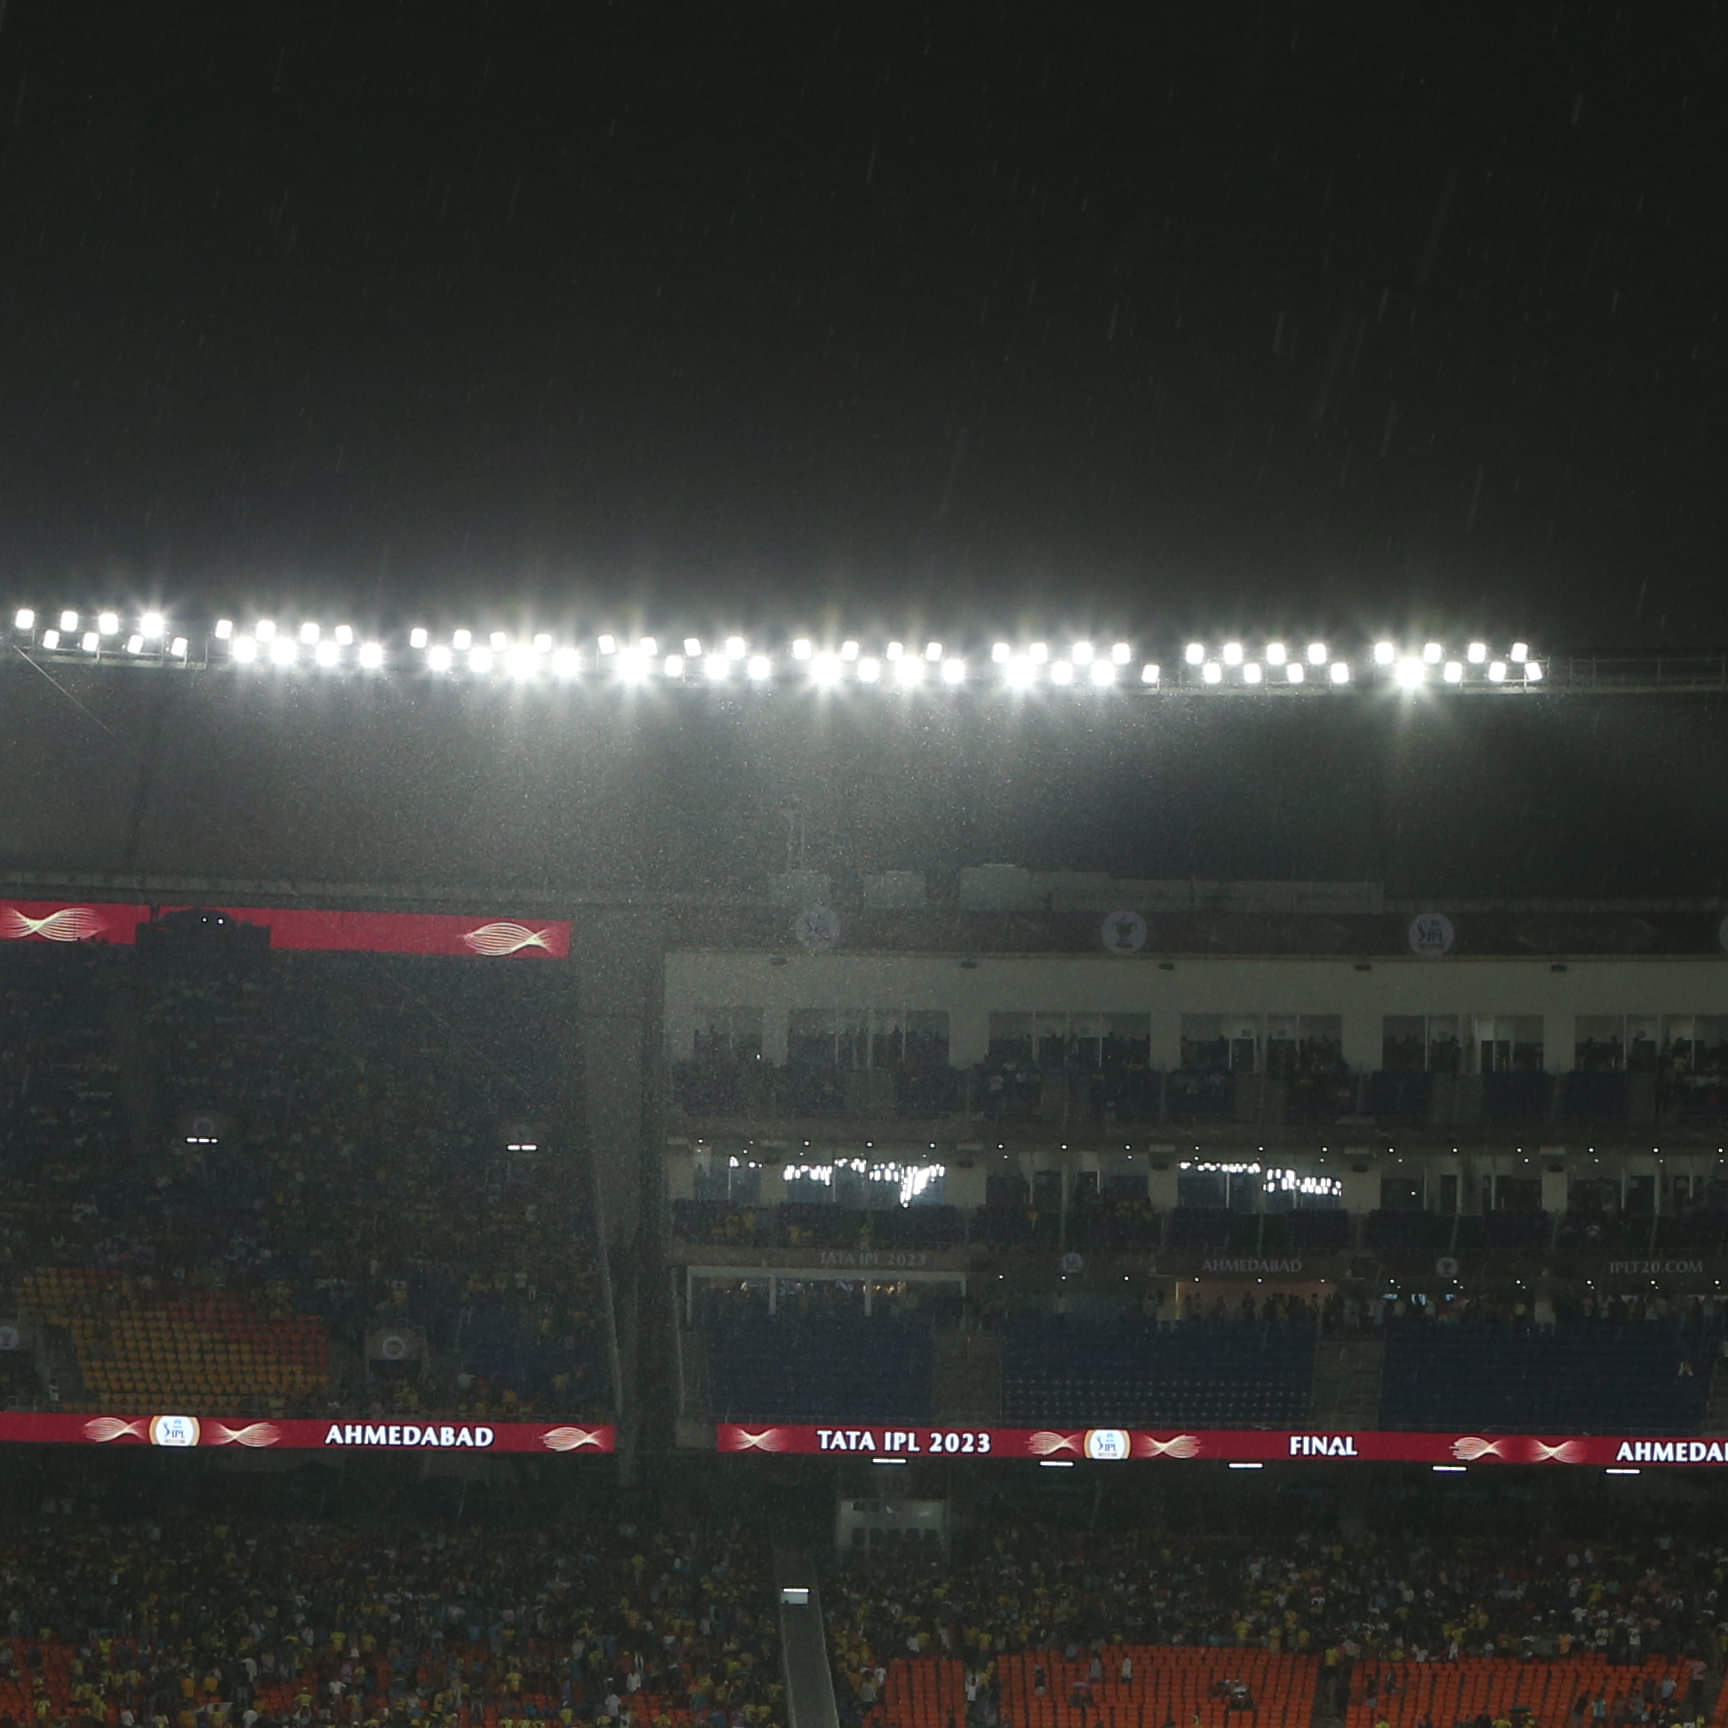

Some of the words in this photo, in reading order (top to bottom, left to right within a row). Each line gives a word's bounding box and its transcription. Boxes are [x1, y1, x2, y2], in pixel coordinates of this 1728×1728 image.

[1201, 1257, 1302, 1273] AHMEDABAD
[325, 1424, 494, 1447] AHMEDABAD
[816, 1430, 876, 1452] TATA
[883, 1431, 921, 1452] IPL
[929, 1432, 991, 1453] 2023
[1290, 1435, 1358, 1456] FINAL
